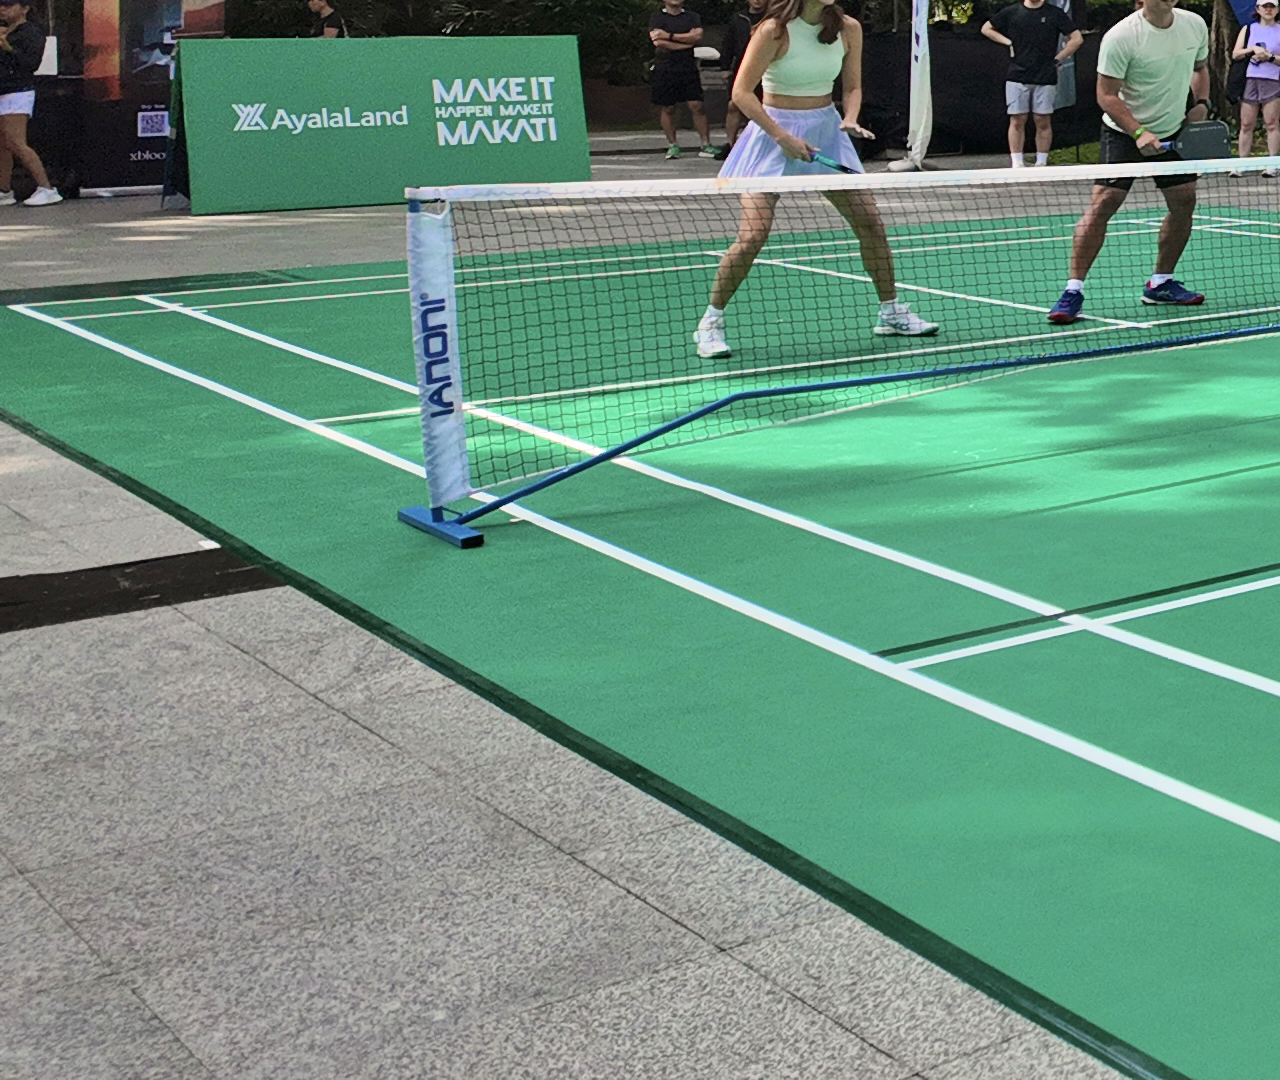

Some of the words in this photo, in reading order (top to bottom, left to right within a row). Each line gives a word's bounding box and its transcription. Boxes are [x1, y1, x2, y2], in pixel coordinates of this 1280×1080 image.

[432, 77, 528, 104] MAKE
[530, 76, 556, 101] IT
[270, 105, 409, 135] AyalaLand
[435, 105, 493, 119] HAPPEN
[499, 103, 542, 117] MAKE
[542, 103, 555, 115] IT
[436, 117, 558, 146] MAKATI
[129, 150, 168, 162] xbloo
